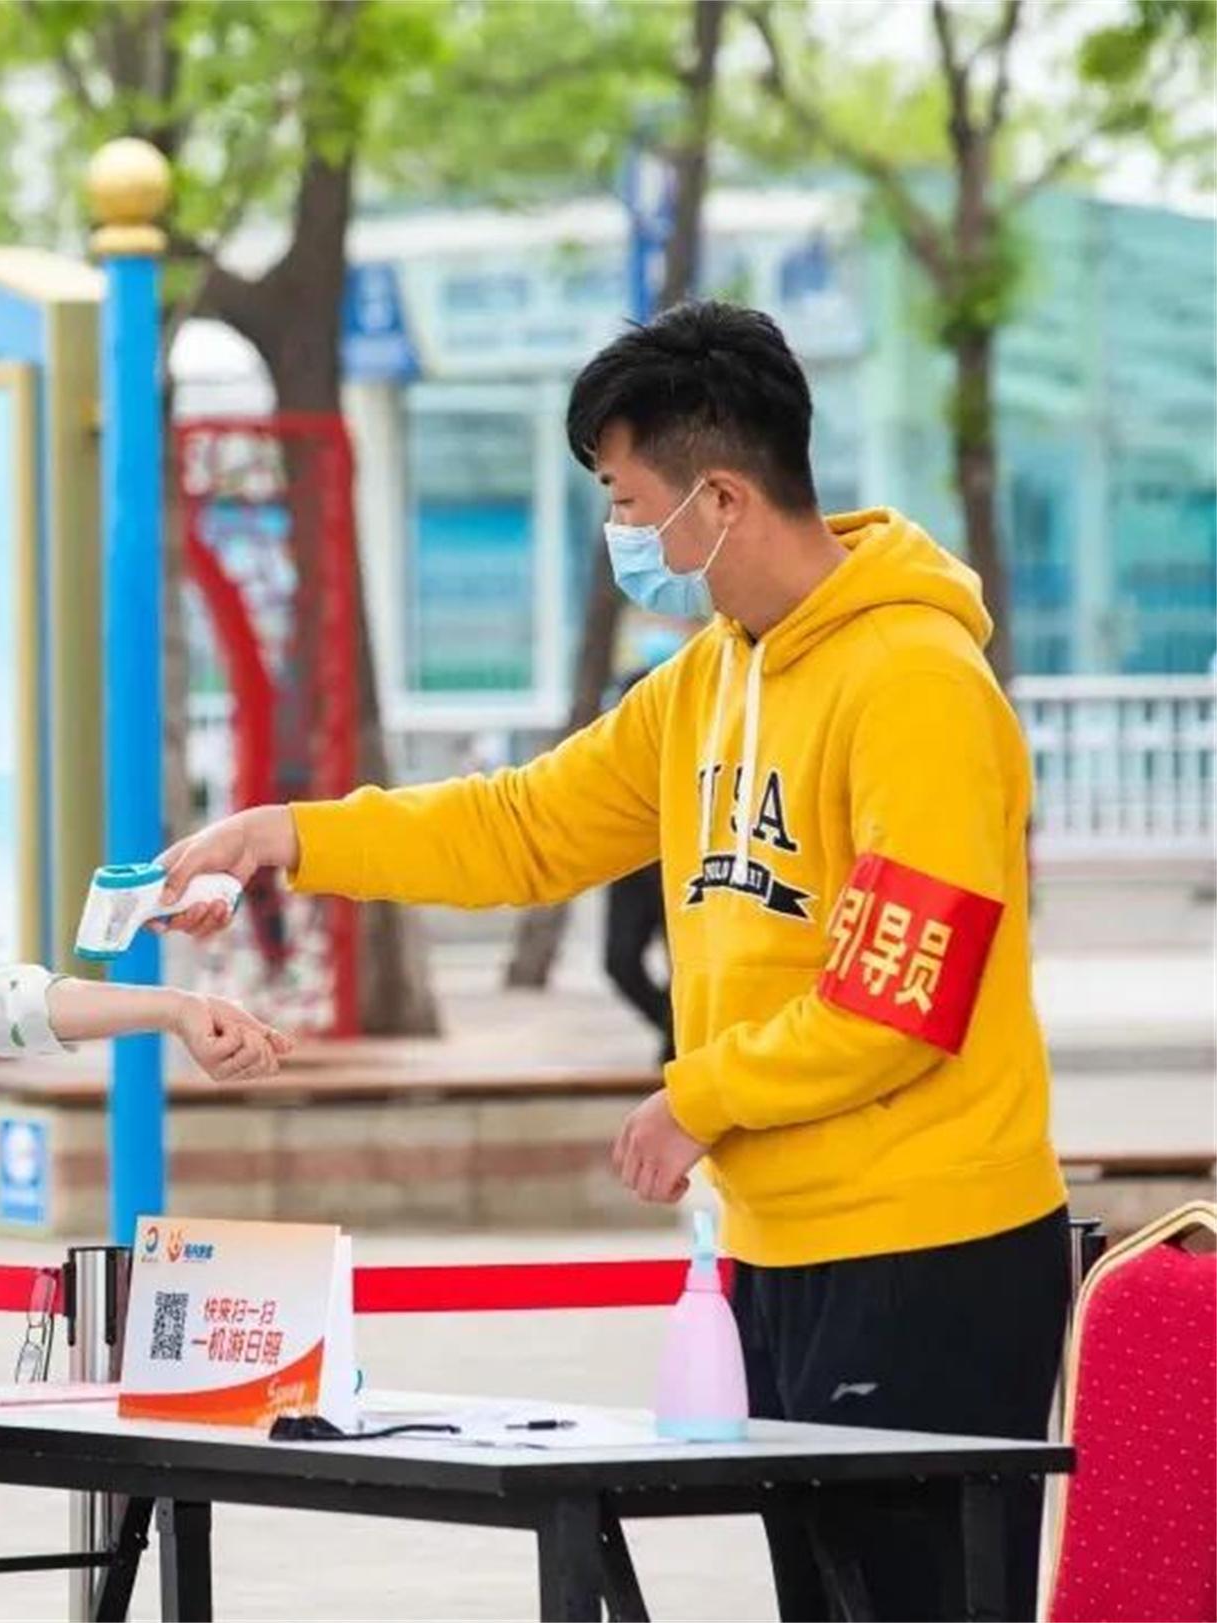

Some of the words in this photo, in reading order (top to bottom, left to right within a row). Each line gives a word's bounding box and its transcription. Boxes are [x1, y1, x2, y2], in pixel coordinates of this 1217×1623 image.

[825, 886, 953, 1015] 引导员
[203, 1297, 277, 1326] 快来扫一扫
[190, 1327, 284, 1364] 一机游日照
